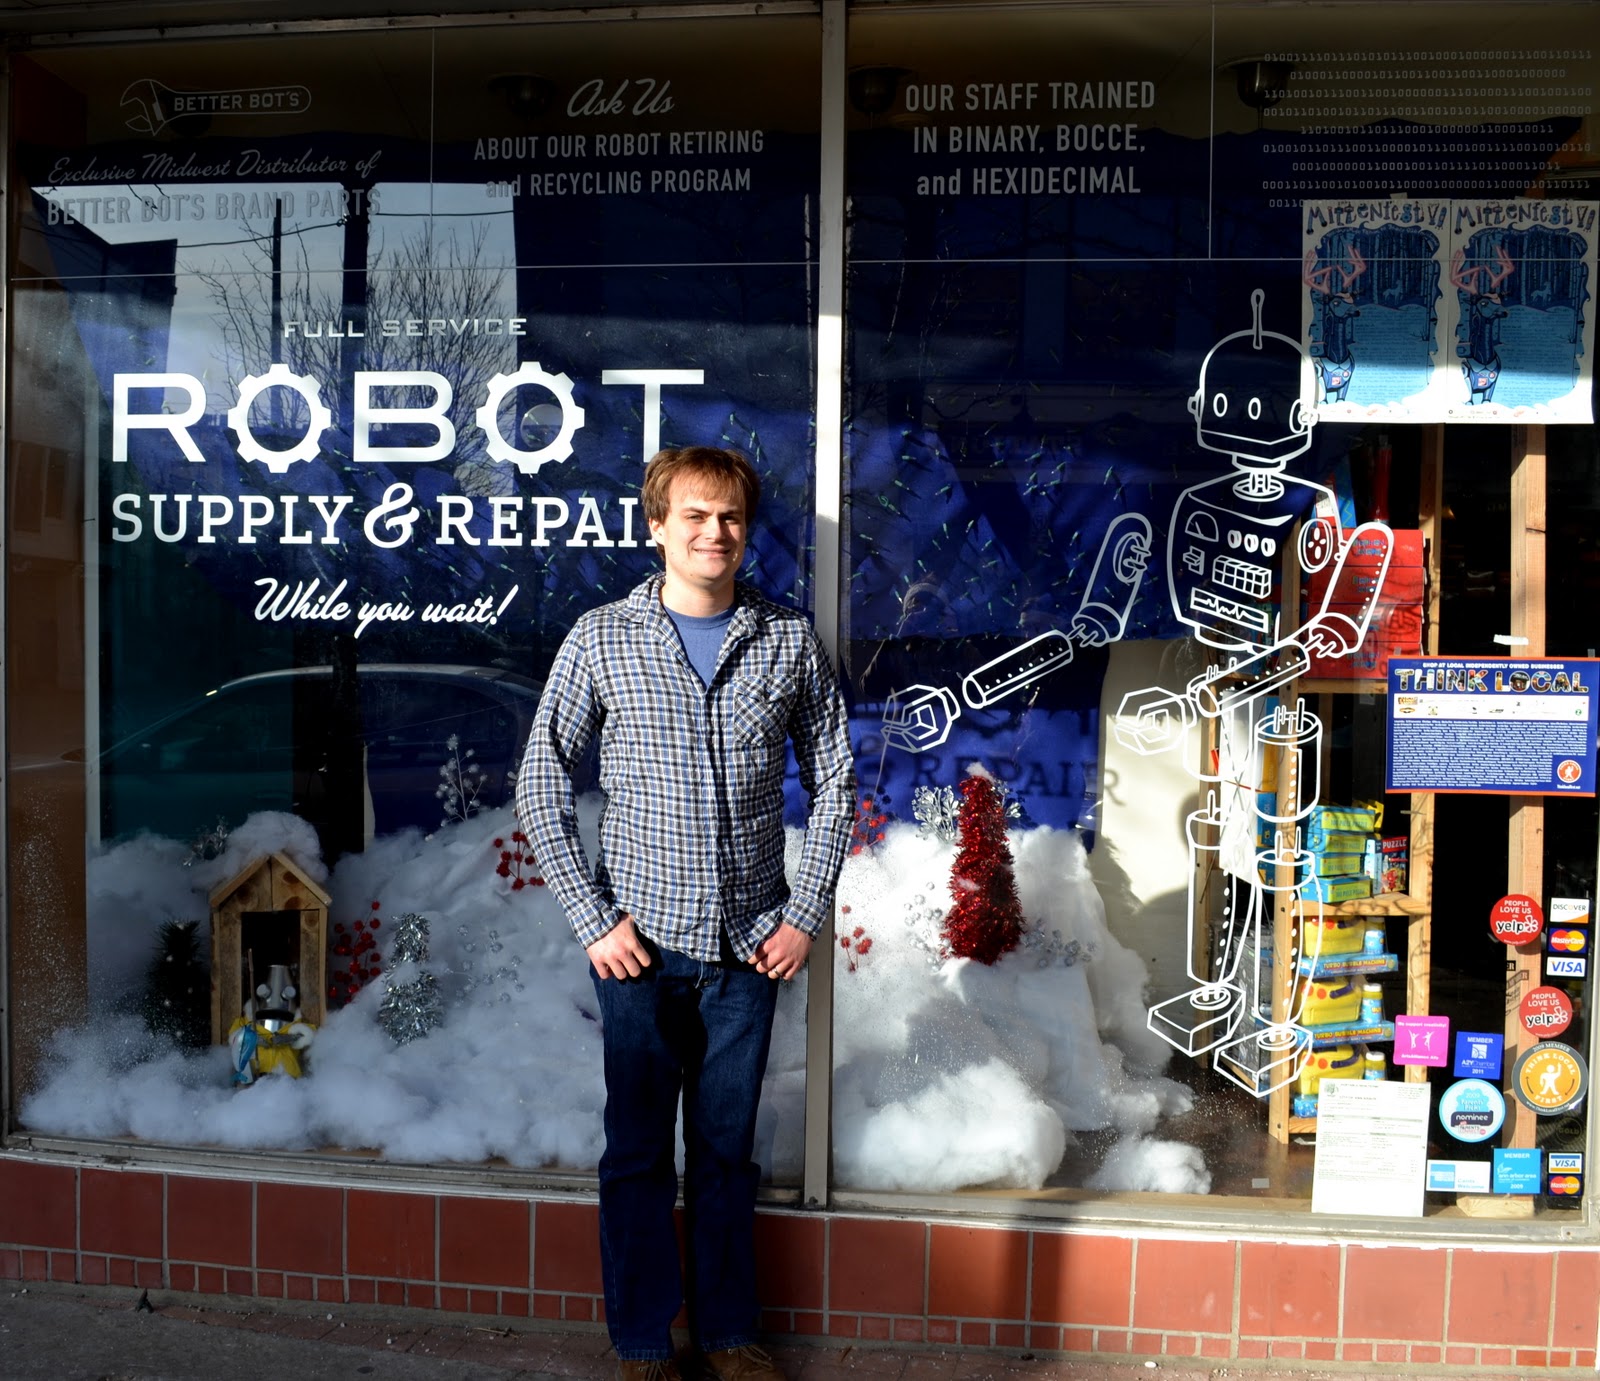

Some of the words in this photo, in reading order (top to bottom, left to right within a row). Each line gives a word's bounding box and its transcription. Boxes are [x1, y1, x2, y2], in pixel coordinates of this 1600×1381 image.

[1264, 51, 1592, 62] 01001111011101010111001000100000011100110111
[1290, 69, 1566, 80] 0100011000010110011001100110001000000
[567, 79, 625, 118] Ask
[631, 79, 675, 117] Us
[905, 84, 954, 112] OUR
[965, 82, 1039, 110] STAFF
[1049, 81, 1155, 109] TRAINED
[1264, 88, 1592, 98] 11010010111001100100000011101000111001001100
[174, 96, 243, 112] BETTER
[249, 91, 299, 108] BOT'S
[1263, 106, 1592, 117] 00101101001011011100110010101100100001000000
[1301, 125, 1554, 135] 1101001011011100010000001100010011
[474, 136, 539, 160] ABOUT
[546, 135, 587, 159] OUR
[595, 132, 661, 157] ROBOT
[669, 130, 764, 155] RETIRING
[913, 127, 937, 153] IN
[949, 125, 1045, 153] BINARY,
[1057, 124, 1146, 153] BOCCE,
[1263, 143, 1591, 153] 01001011011100110000101110010011110010010110
[48, 157, 136, 184] Exclusive
[141, 152, 232, 180] Midwest
[236, 149, 348, 176] Distributor
[355, 150, 382, 178] of
[1292, 162, 1560, 171] 000100000011000100110111101100011011
[486, 174, 521, 198] and
[530, 170, 642, 196] RECYCLING
[651, 168, 751, 193] PROGRAM
[917, 168, 961, 195] and
[973, 166, 1141, 194] HEXIDECIMAL
[1262, 180, 1590, 190] 00011011001010010110000100000011000010110111
[47, 196, 135, 226] BETTER
[140, 194, 205, 222] BOT'S
[215, 191, 295, 220] BRAND
[305, 188, 381, 217] PARTS
[284, 320, 364, 338] FULL
[382, 318, 527, 337] SERVICE
[112, 361, 704, 474] ROBOT
[112, 493, 354, 544] SUPPLY
[364, 482, 420, 549] &
[436, 495, 657, 547] REPAI
[254, 577, 350, 621] While
[354, 599, 415, 639] you
[422, 585, 519, 626] wait!
[1395, 668, 1489, 692] THINK
[1494, 670, 1589, 693] LOCAL
[1382, 838, 1407, 849] PUZZLE
[1553, 903, 1586, 911] DISCOVER
[1496, 920, 1525, 934] yelp
[1551, 937, 1585, 945] MasterCard
[1551, 961, 1583, 973] VISA
[1526, 1013, 1554, 1026] yelp
[1546, 1043, 1571, 1052] MEMBER
[1525, 1053, 1550, 1073] THINK
[1552, 1053, 1576, 1075] LOCAL
[1534, 1095, 1563, 1104] FIRST
[1455, 1113, 1488, 1121] nominee
